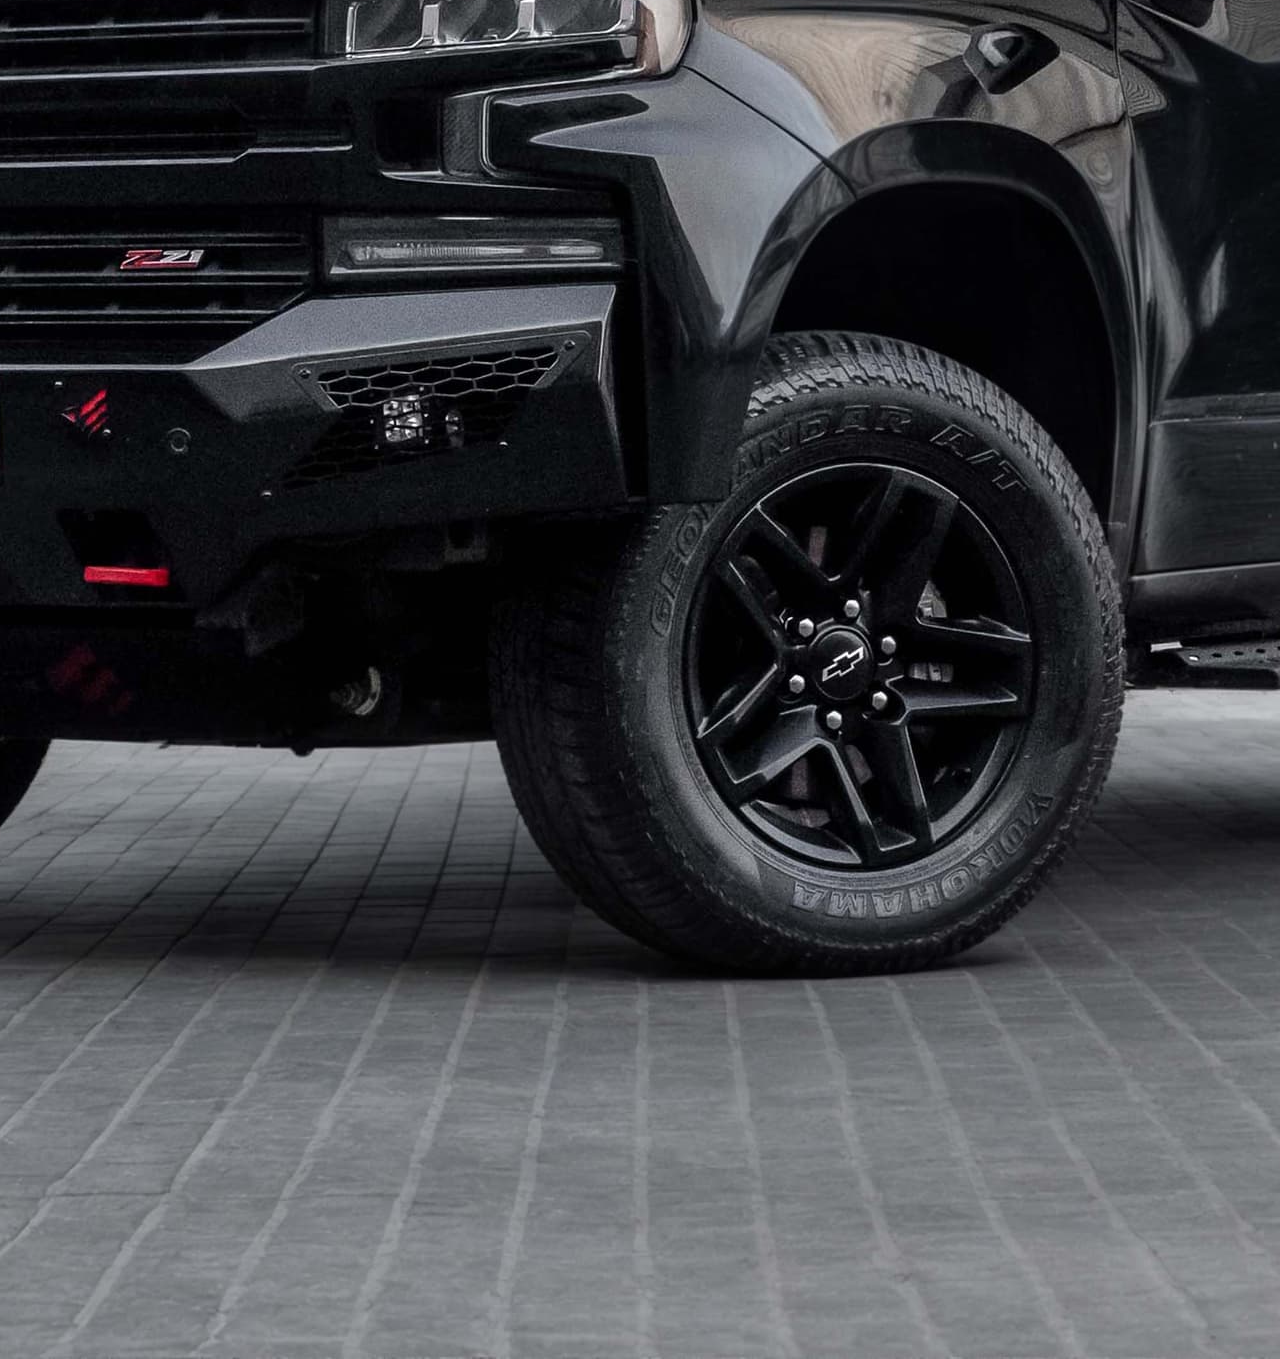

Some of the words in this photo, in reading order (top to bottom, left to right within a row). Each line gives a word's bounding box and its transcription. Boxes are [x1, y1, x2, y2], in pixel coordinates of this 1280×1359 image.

[120, 249, 205, 269] Z71
[928, 423, 1029, 492] A/T
[791, 791, 1056, 919] YOKOHAMA
